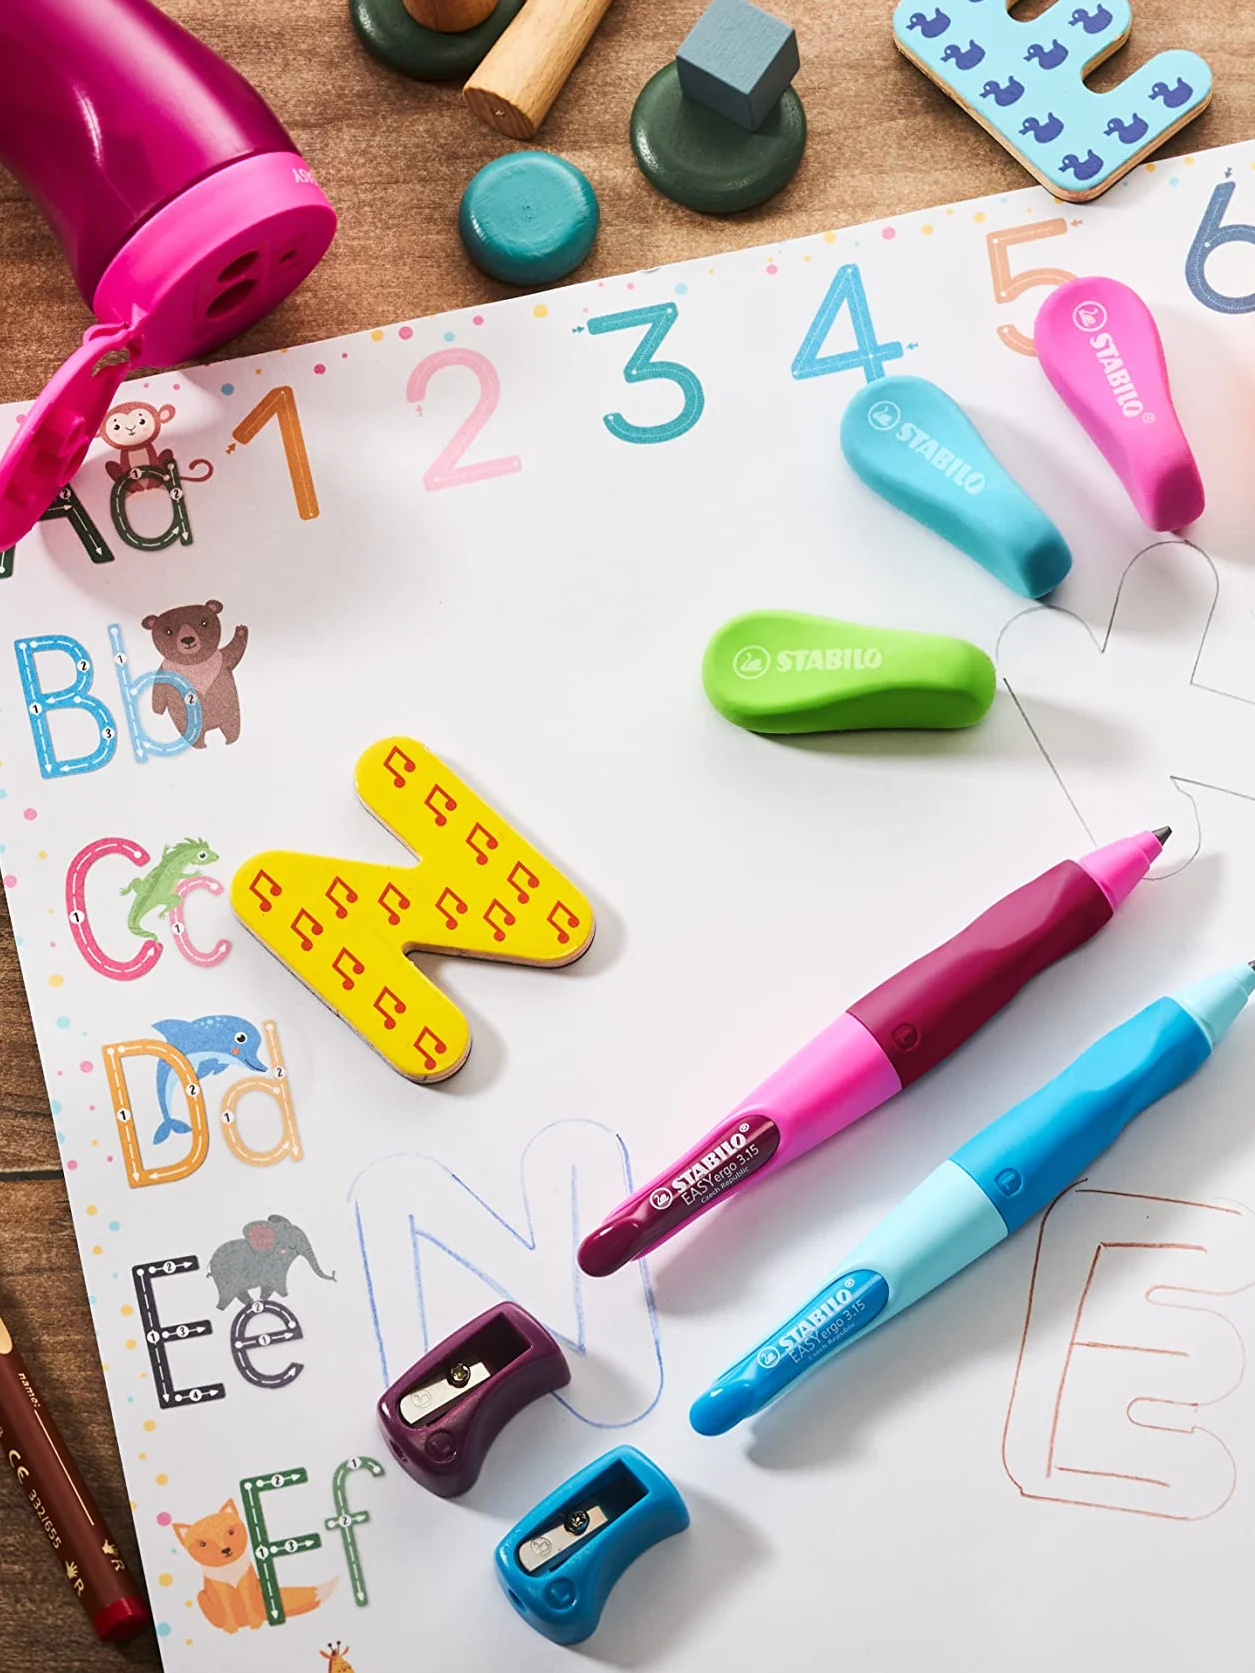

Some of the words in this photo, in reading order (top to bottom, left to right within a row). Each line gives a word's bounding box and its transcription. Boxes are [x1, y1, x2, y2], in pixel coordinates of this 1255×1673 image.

[790, 263, 905, 384] 4
[985, 217, 1078, 357] 5
[586, 301, 706, 445] 3
[1089, 332, 1144, 418] STABILO
[232, 385, 320, 521] 1
[405, 347, 524, 492] 2
[895, 422, 986, 495] STABILO
[776, 648, 882, 673] STABILO
[671, 1133, 747, 1193] STABILO
[681, 1162, 737, 1206] EASYergo
[736, 1144, 759, 1165] 3.15
[778, 1289, 853, 1352] STABILO
[788, 1319, 844, 1363] EASYergo
[843, 1301, 865, 1321] 3.15
[18, 1372, 41, 1408] name:
